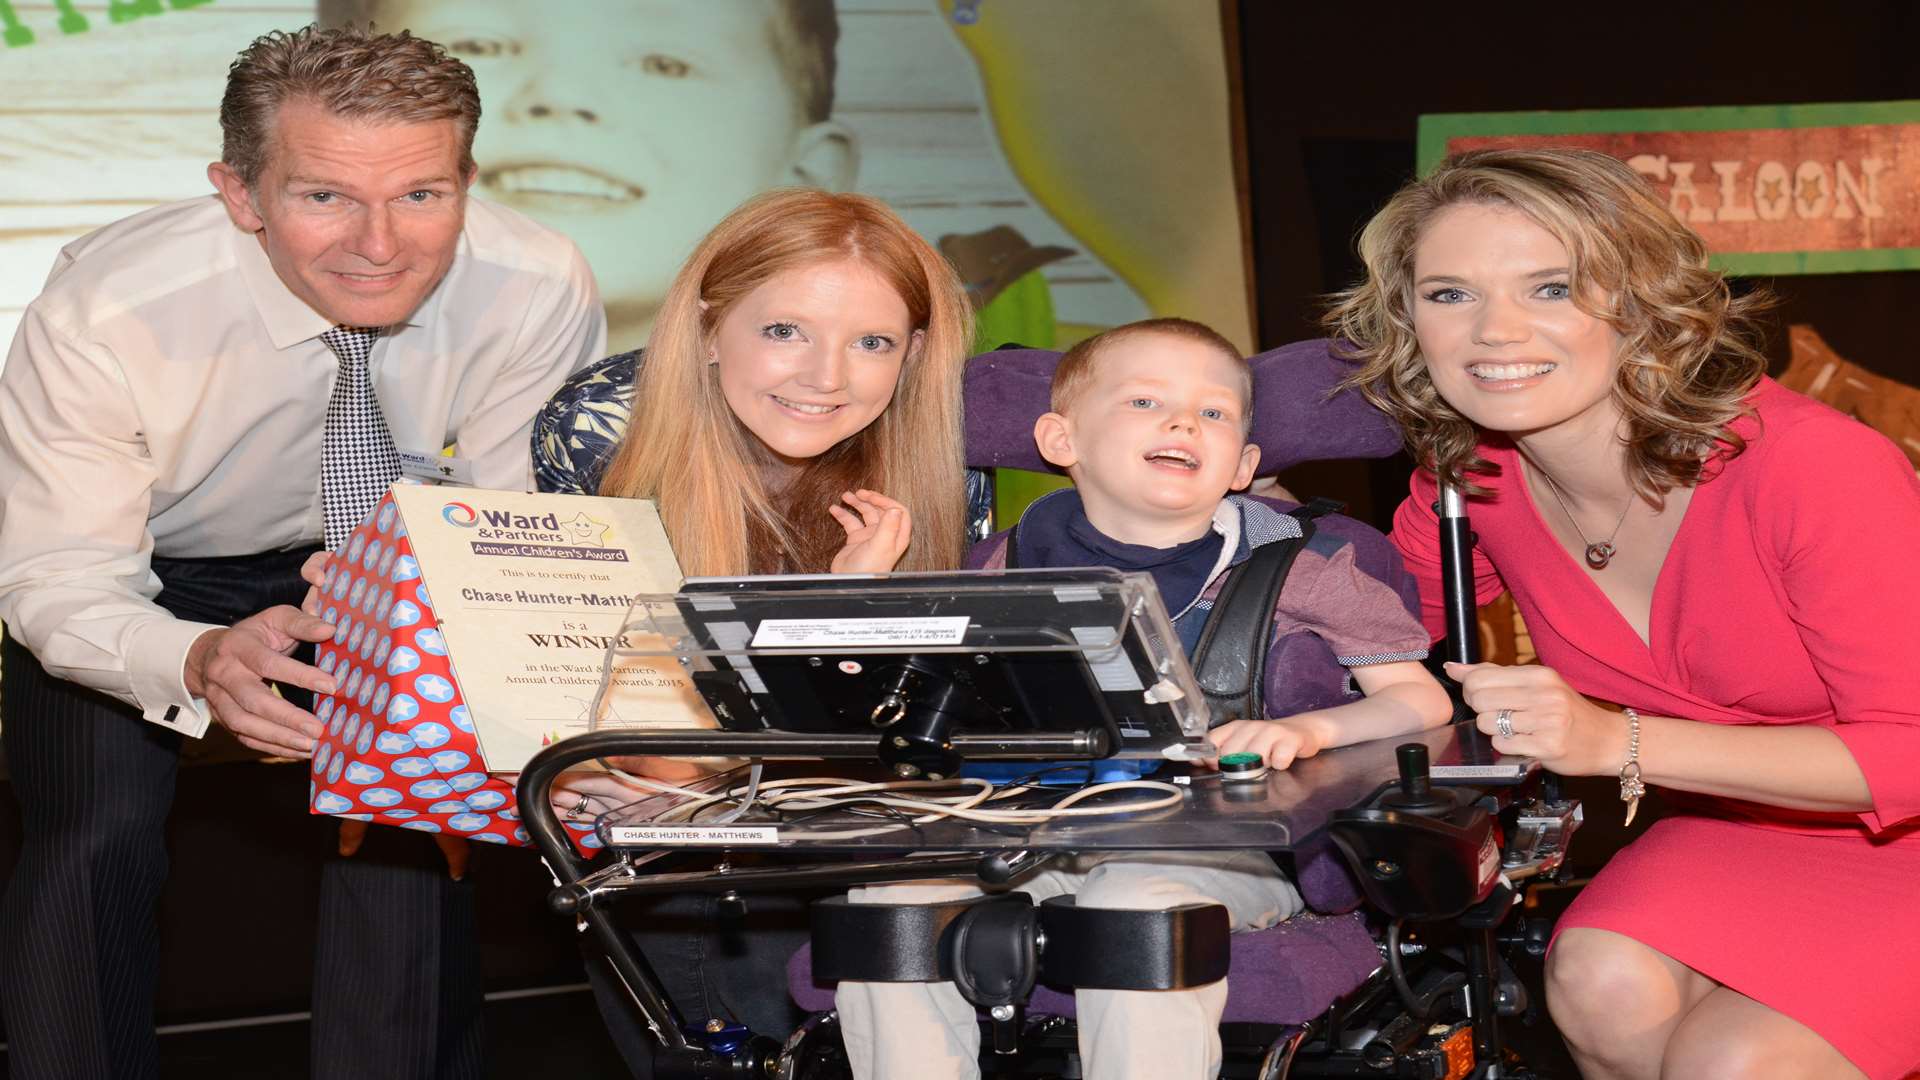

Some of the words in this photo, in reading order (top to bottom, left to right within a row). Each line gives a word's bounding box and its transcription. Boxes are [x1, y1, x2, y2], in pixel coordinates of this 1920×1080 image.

[482, 510, 560, 530] Ward
[478, 528, 492, 538] &
[495, 529, 564, 542] Partners
[475, 543, 518, 556] Annual
[521, 545, 582, 559] Children's
[585, 550, 625, 561] Award
[499, 569, 524, 577] This
[527, 570, 536, 578] is
[552, 573, 586, 582] certify
[590, 573, 611, 582] that
[462, 588, 512, 603] Chase
[562, 621, 576, 631] is
[579, 624, 588, 632] a
[525, 663, 536, 673] in
[540, 664, 560, 673] the
[562, 664, 593, 674] Ward
[505, 676, 547, 685] Annual
[612, 679, 655, 688] Awards
[657, 680, 685, 689] 2015
[624, 831, 657, 840] CHASE
[659, 831, 699, 840] HUNTER
[708, 832, 763, 840] MATTHEWS
